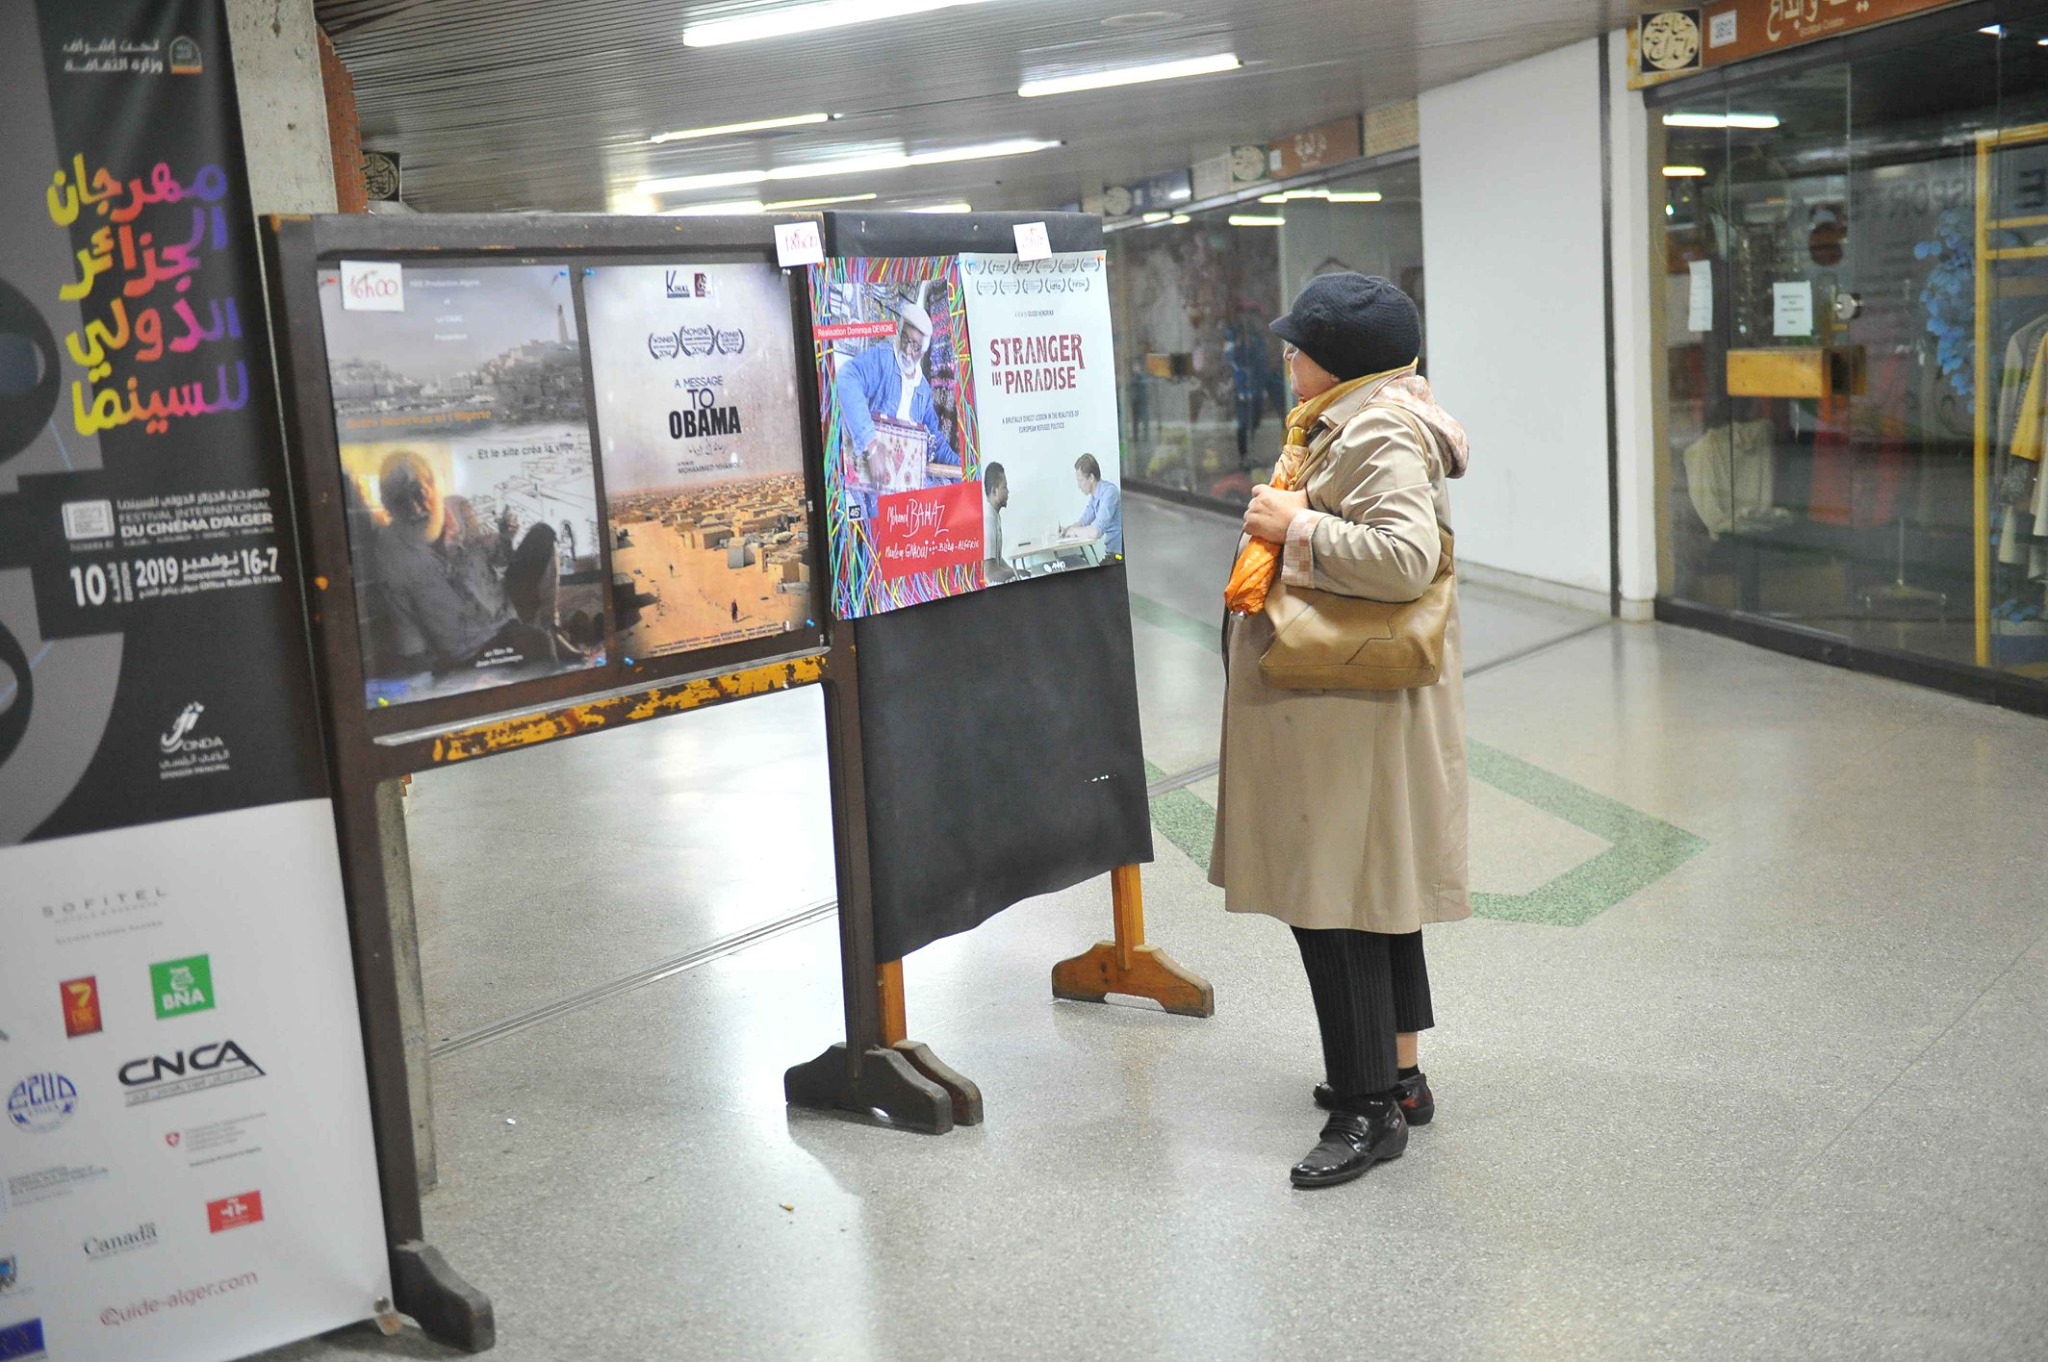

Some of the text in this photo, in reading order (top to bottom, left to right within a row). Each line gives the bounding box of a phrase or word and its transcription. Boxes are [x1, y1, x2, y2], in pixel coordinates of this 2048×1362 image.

[46, 152, 229, 227] مهرجان
[58, 205, 228, 301] الجزائر
[65, 296, 243, 382] الدولي
[989, 333, 1086, 370] STRANGER
[674, 375, 724, 389] A MESSAGE
[1004, 365, 1077, 394] PARADISE
[71, 360, 249, 437] للسينما
[686, 387, 715, 411] TO
[668, 405, 742, 440] OBAMA
[478, 448, 491, 460] Et
[120, 523, 145, 539] DU
[209, 511, 274, 530] D'ALGER
[69, 562, 108, 608] 10
[134, 555, 180, 588] 2019
[181, 550, 240, 574] نوفمبر
[41, 887, 169, 919] SOFITEL
[68, 981, 92, 1008] 7
[161, 987, 207, 1012] BNA
[117, 1038, 268, 1088] CNCA
[83, 1222, 158, 1256] Canada
